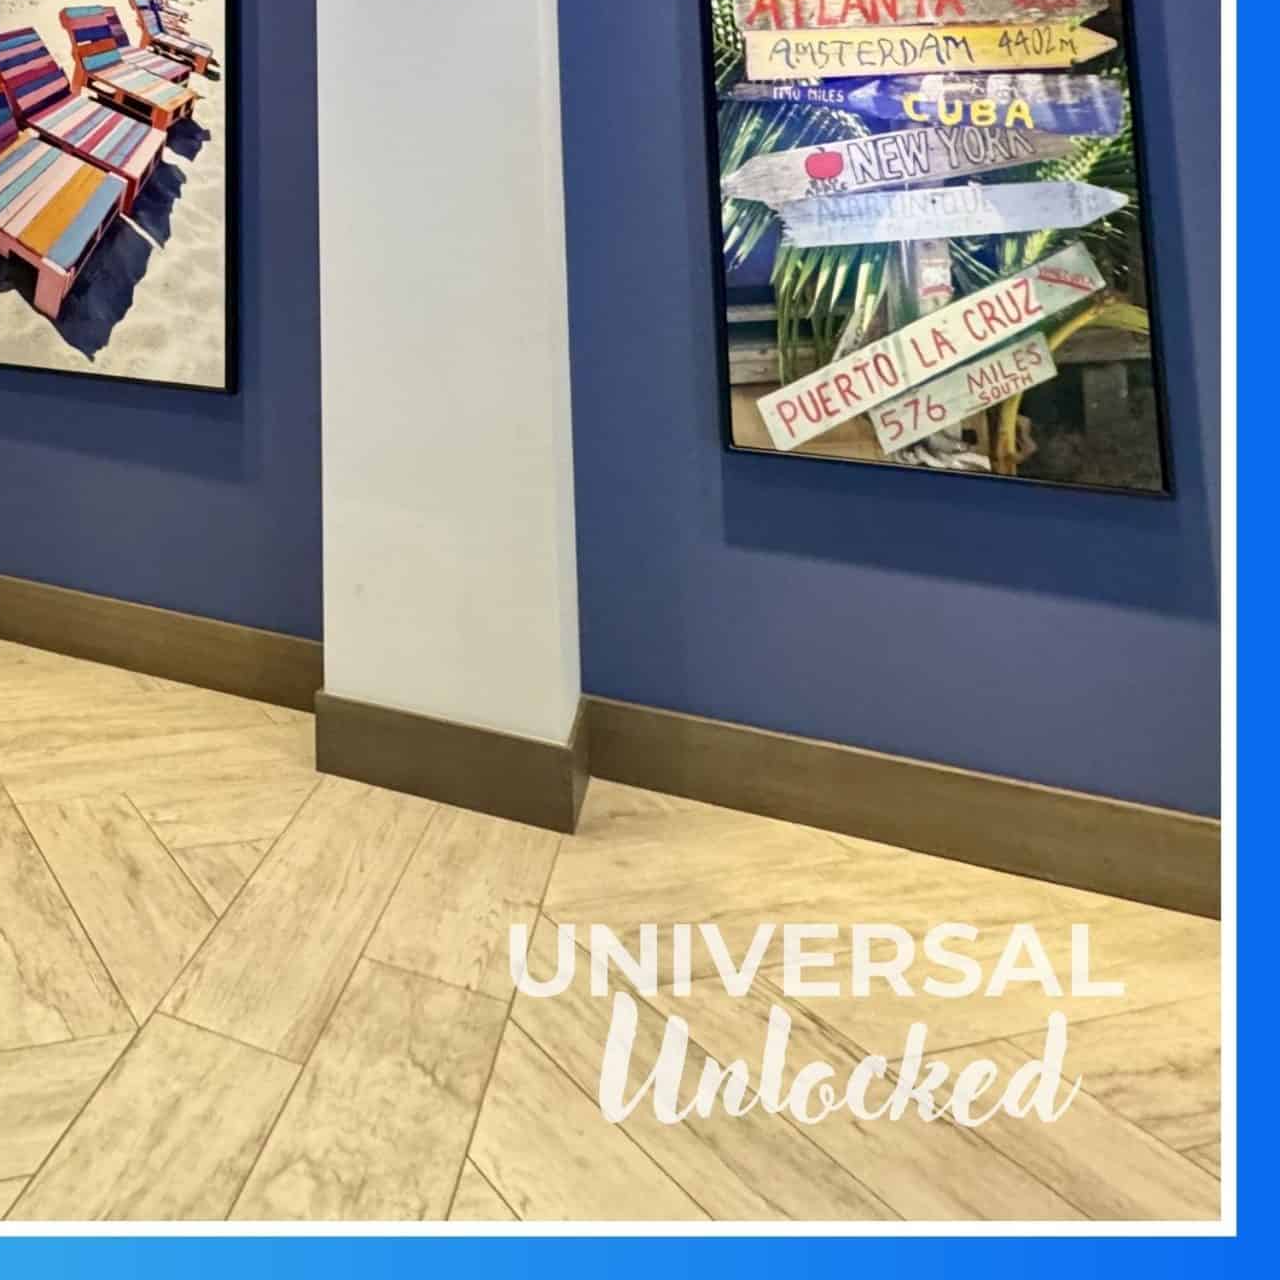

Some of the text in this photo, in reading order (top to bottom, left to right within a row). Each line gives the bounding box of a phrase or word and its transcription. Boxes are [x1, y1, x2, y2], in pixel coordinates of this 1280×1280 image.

[769, 33, 975, 69] AMSTERDAM
[902, 91, 1035, 129] CUBA
[847, 127, 1036, 185] NEW YORK
[776, 278, 1043, 439] PUERTO LA CRUZ
[880, 342, 1042, 442] 576 MILES
[978, 373, 1034, 406] SOUTH
